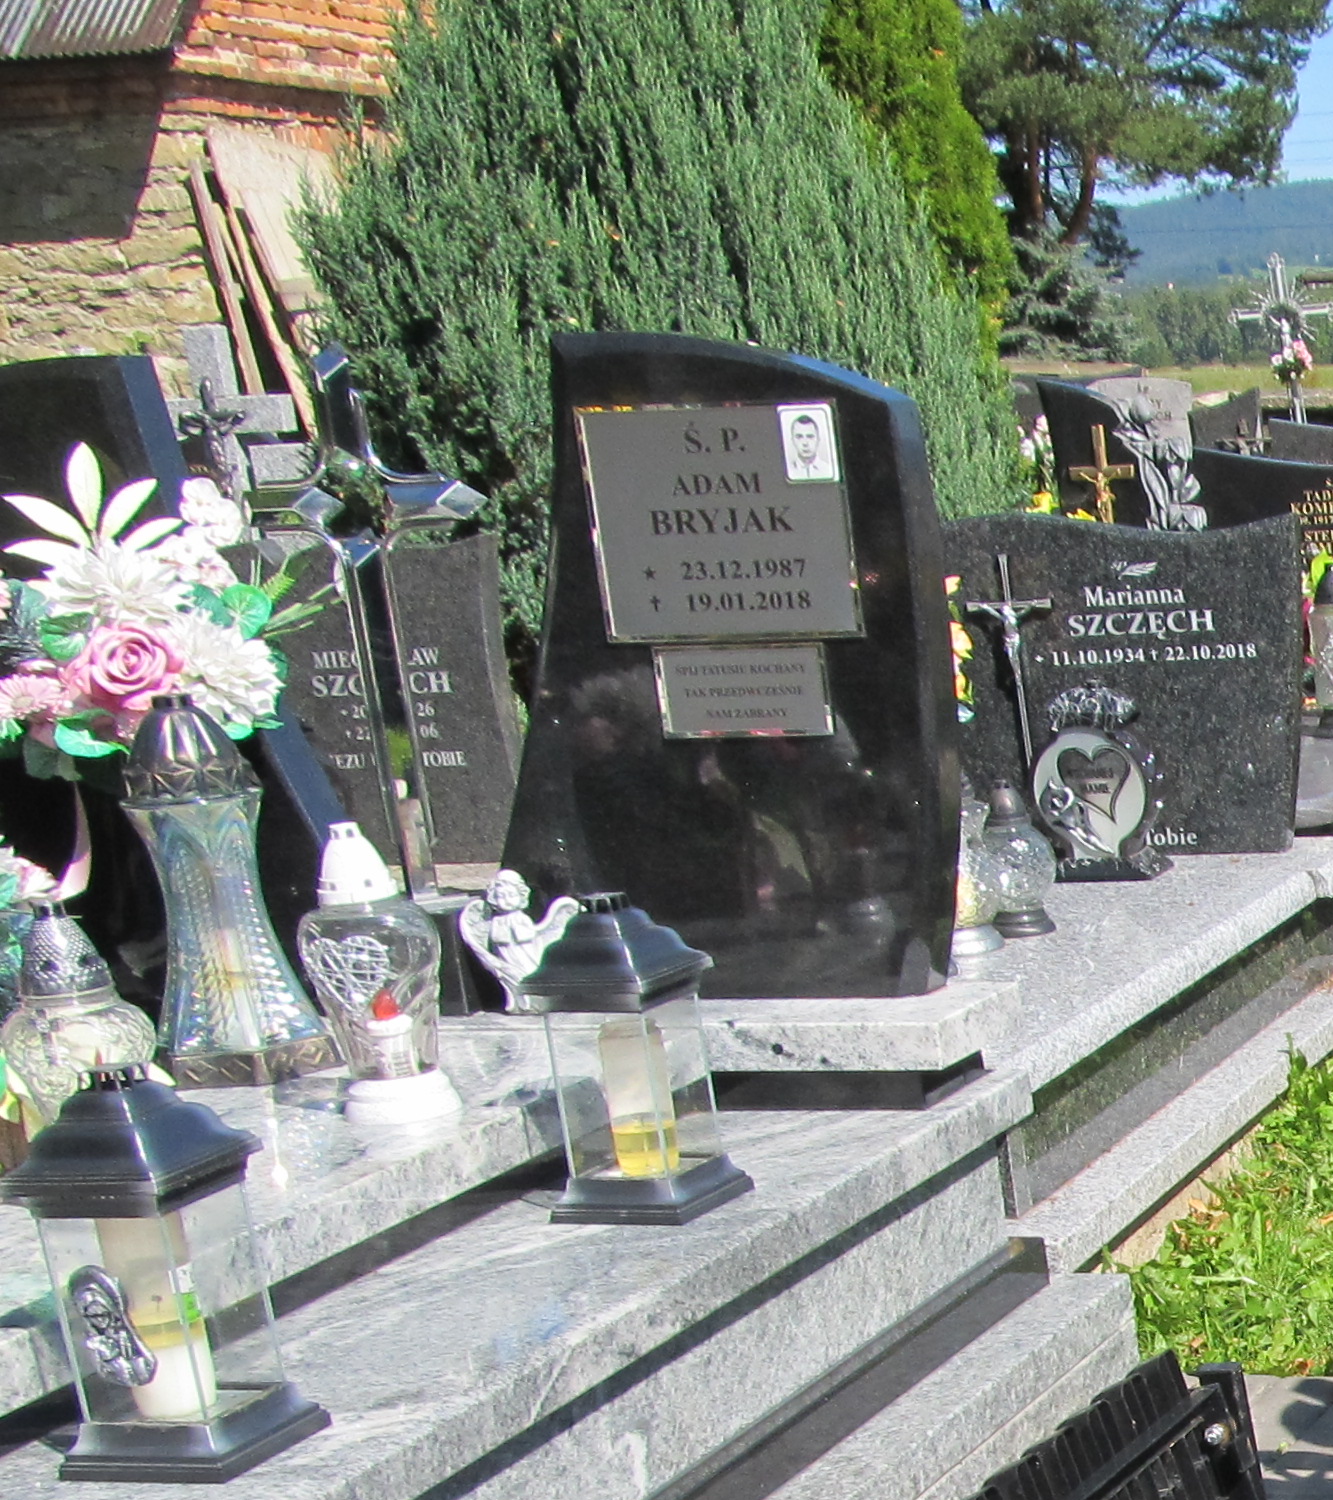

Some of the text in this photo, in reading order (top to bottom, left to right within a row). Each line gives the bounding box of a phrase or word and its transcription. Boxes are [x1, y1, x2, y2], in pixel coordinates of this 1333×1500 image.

[721, 427, 746, 451] P.
[672, 472, 762, 496] ADAM
[649, 505, 794, 536] BRYJAK
[680, 558, 806, 581] 23.12.1987
[686, 590, 813, 613] 19.01.2018
[1083, 585, 1186, 608] Marianna
[1067, 608, 1216, 640] SZCZĘCH
[1052, 643, 1257, 666] 11.10.1934 22.10.2018
